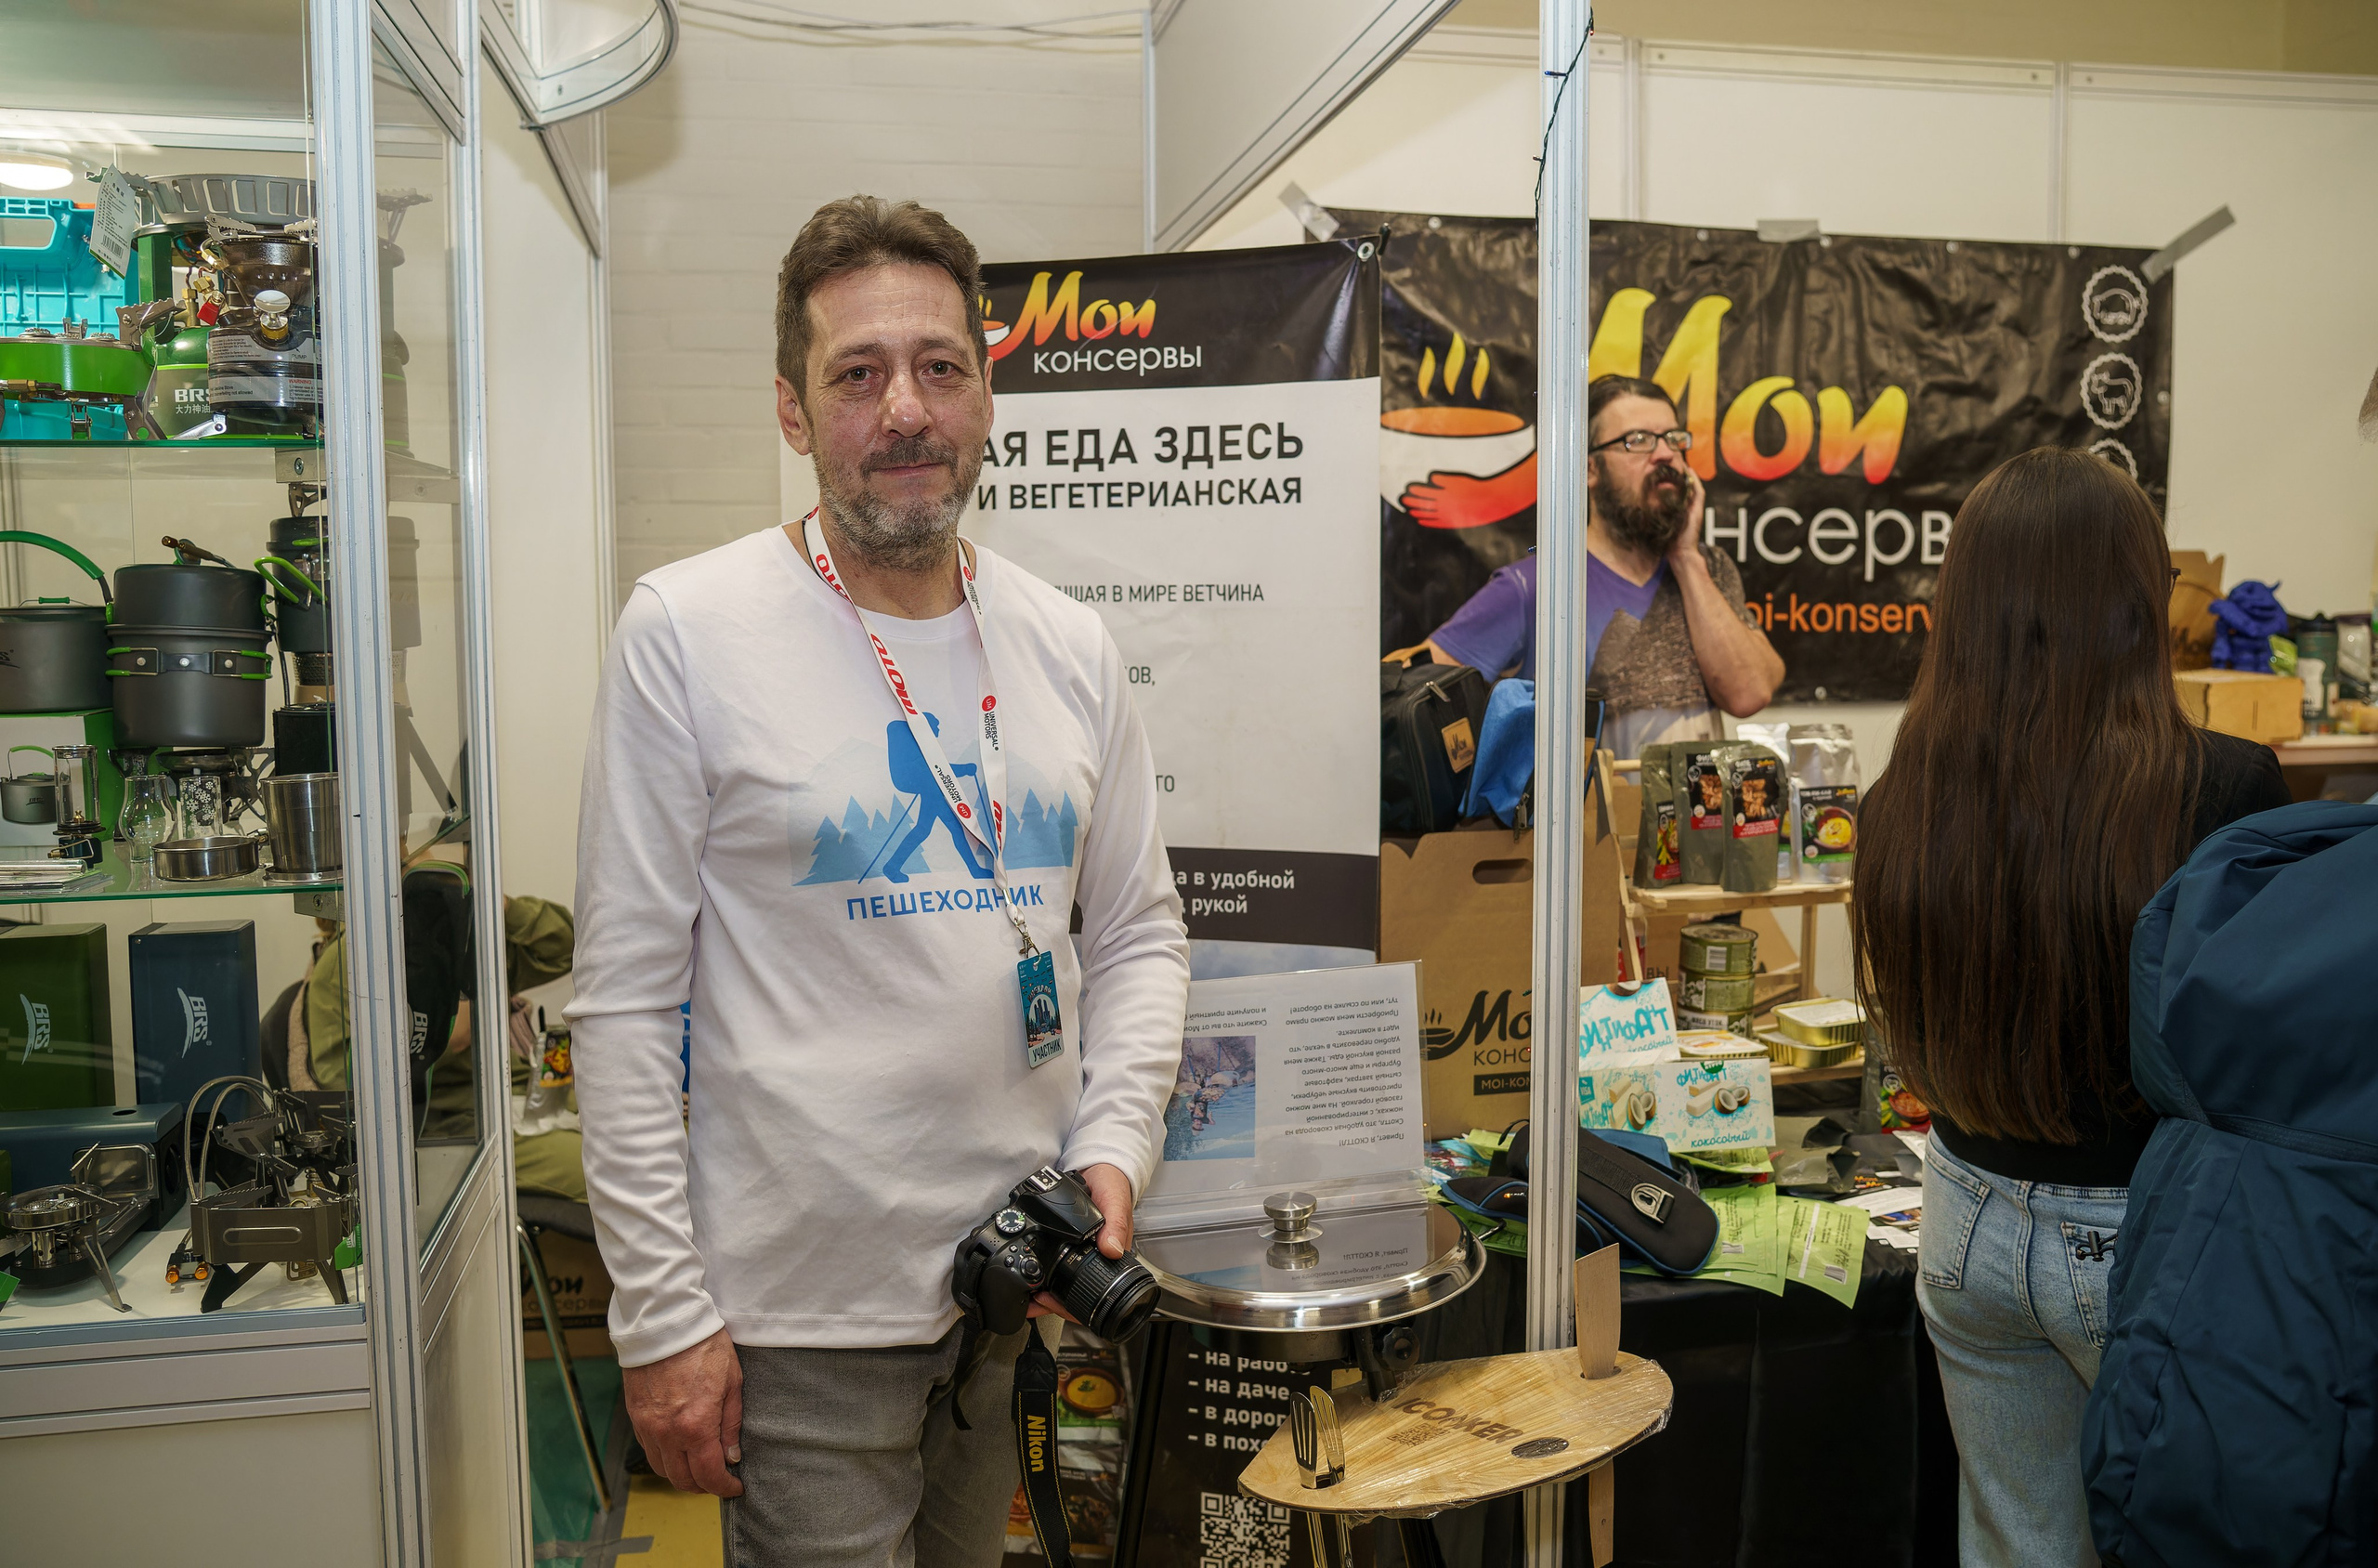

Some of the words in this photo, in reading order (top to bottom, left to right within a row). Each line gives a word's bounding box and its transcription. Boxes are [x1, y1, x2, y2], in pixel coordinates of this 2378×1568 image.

[1006, 270, 1156, 346] Мои
[1033, 346, 1203, 377] консервы
[1046, 427, 1139, 473] ЕДА
[1154, 422, 1304, 471] ЗДЕСЬ
[977, 484, 997, 510] И
[1010, 477, 1302, 510] ВЕГЕТЕРИАНСКАЯ
[1113, 585, 1123, 602] В
[1129, 585, 1177, 602] МИРЕ
[1183, 583, 1264, 602] ВЕТЧИНА
[1125, 666, 1156, 686] ОВ,
[989, 712, 999, 748] UNIVERSAL
[937, 768, 959, 804] UNIVERSAL
[946, 775, 962, 802] MOTORS
[1194, 871, 1205, 885] в
[1210, 869, 1295, 890] удобной
[846, 884, 1044, 921] ПЕШЕХОДНИК
[1192, 894, 1248, 916] рукой
[1190, 1011, 1224, 1021] приятный
[1290, 1004, 1322, 1014] обороте!
[1357, 1010, 1399, 1019] Приобрести
[32, 1002, 50, 1050] BRS
[189, 996, 208, 1043] BRS
[1336, 1027, 1376, 1036] комплекте.
[1332, 1039, 1372, 1048] перевозить
[1374, 1036, 1400, 1045] удобно
[1032, 1041, 1062, 1062] УЧАСТНИК
[1346, 1051, 1374, 1060] вкусной
[1376, 1047, 1401, 1057] разной
[1304, 1055, 1326, 1064] Также
[1372, 1060, 1402, 1069] бургеры
[1302, 1065, 1348, 1075] много-много
[1376, 1072, 1402, 1080] сытный
[1359, 1083, 1402, 1092] приготовить
[1339, 1099, 1373, 1108] горелкой.
[1376, 1095, 1403, 1104] газовой
[1306, 1111, 1368, 1123] интегрированной
[1296, 1126, 1332, 1134] сковорода
[1334, 1121, 1364, 1130] удобная
[1339, 1138, 1369, 1146] СКОТТЛ!
[1691, 1131, 1751, 1148] кокосовый
[1205, 1351, 1231, 1366] на
[1205, 1378, 1231, 1393] на
[1236, 1381, 1290, 1400] даче
[1205, 1406, 1218, 1420] в
[1027, 1415, 1046, 1472] Nikon
[1205, 1433, 1218, 1447] в
